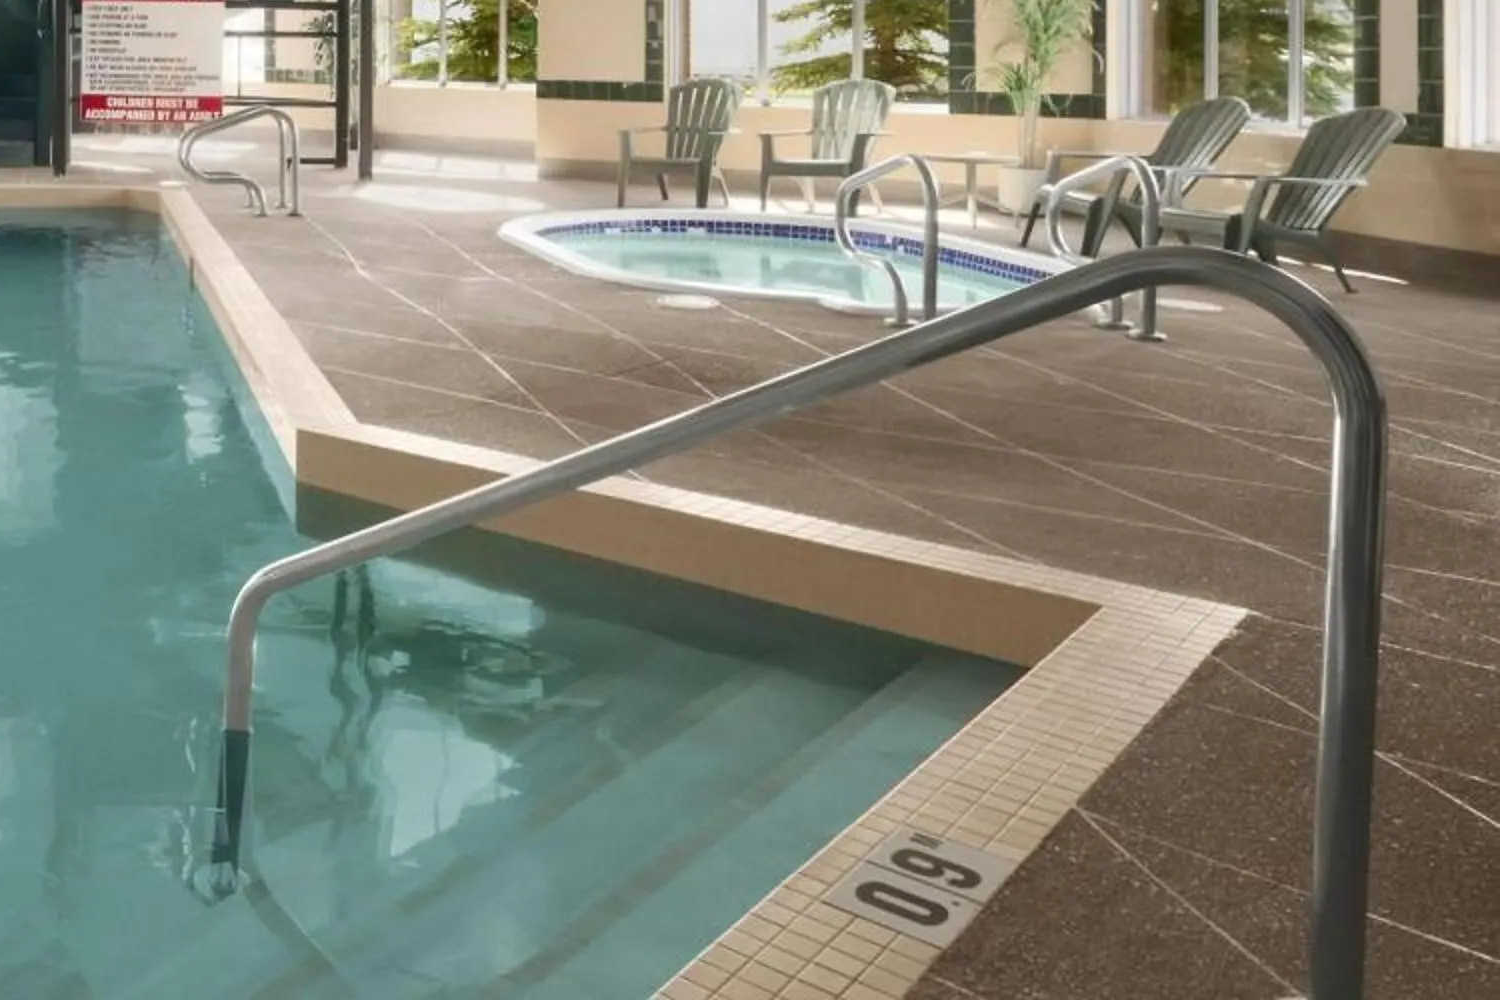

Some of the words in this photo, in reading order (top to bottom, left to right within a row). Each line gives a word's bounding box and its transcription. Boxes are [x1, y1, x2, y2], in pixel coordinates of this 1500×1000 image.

[106, 96, 153, 108] CHILDREN
[156, 96, 183, 109] MUST
[185, 96, 199, 109] BE
[84, 108, 155, 120] ACCOMPANIED
[157, 109, 170, 121] BY
[173, 110, 188, 121] AN
